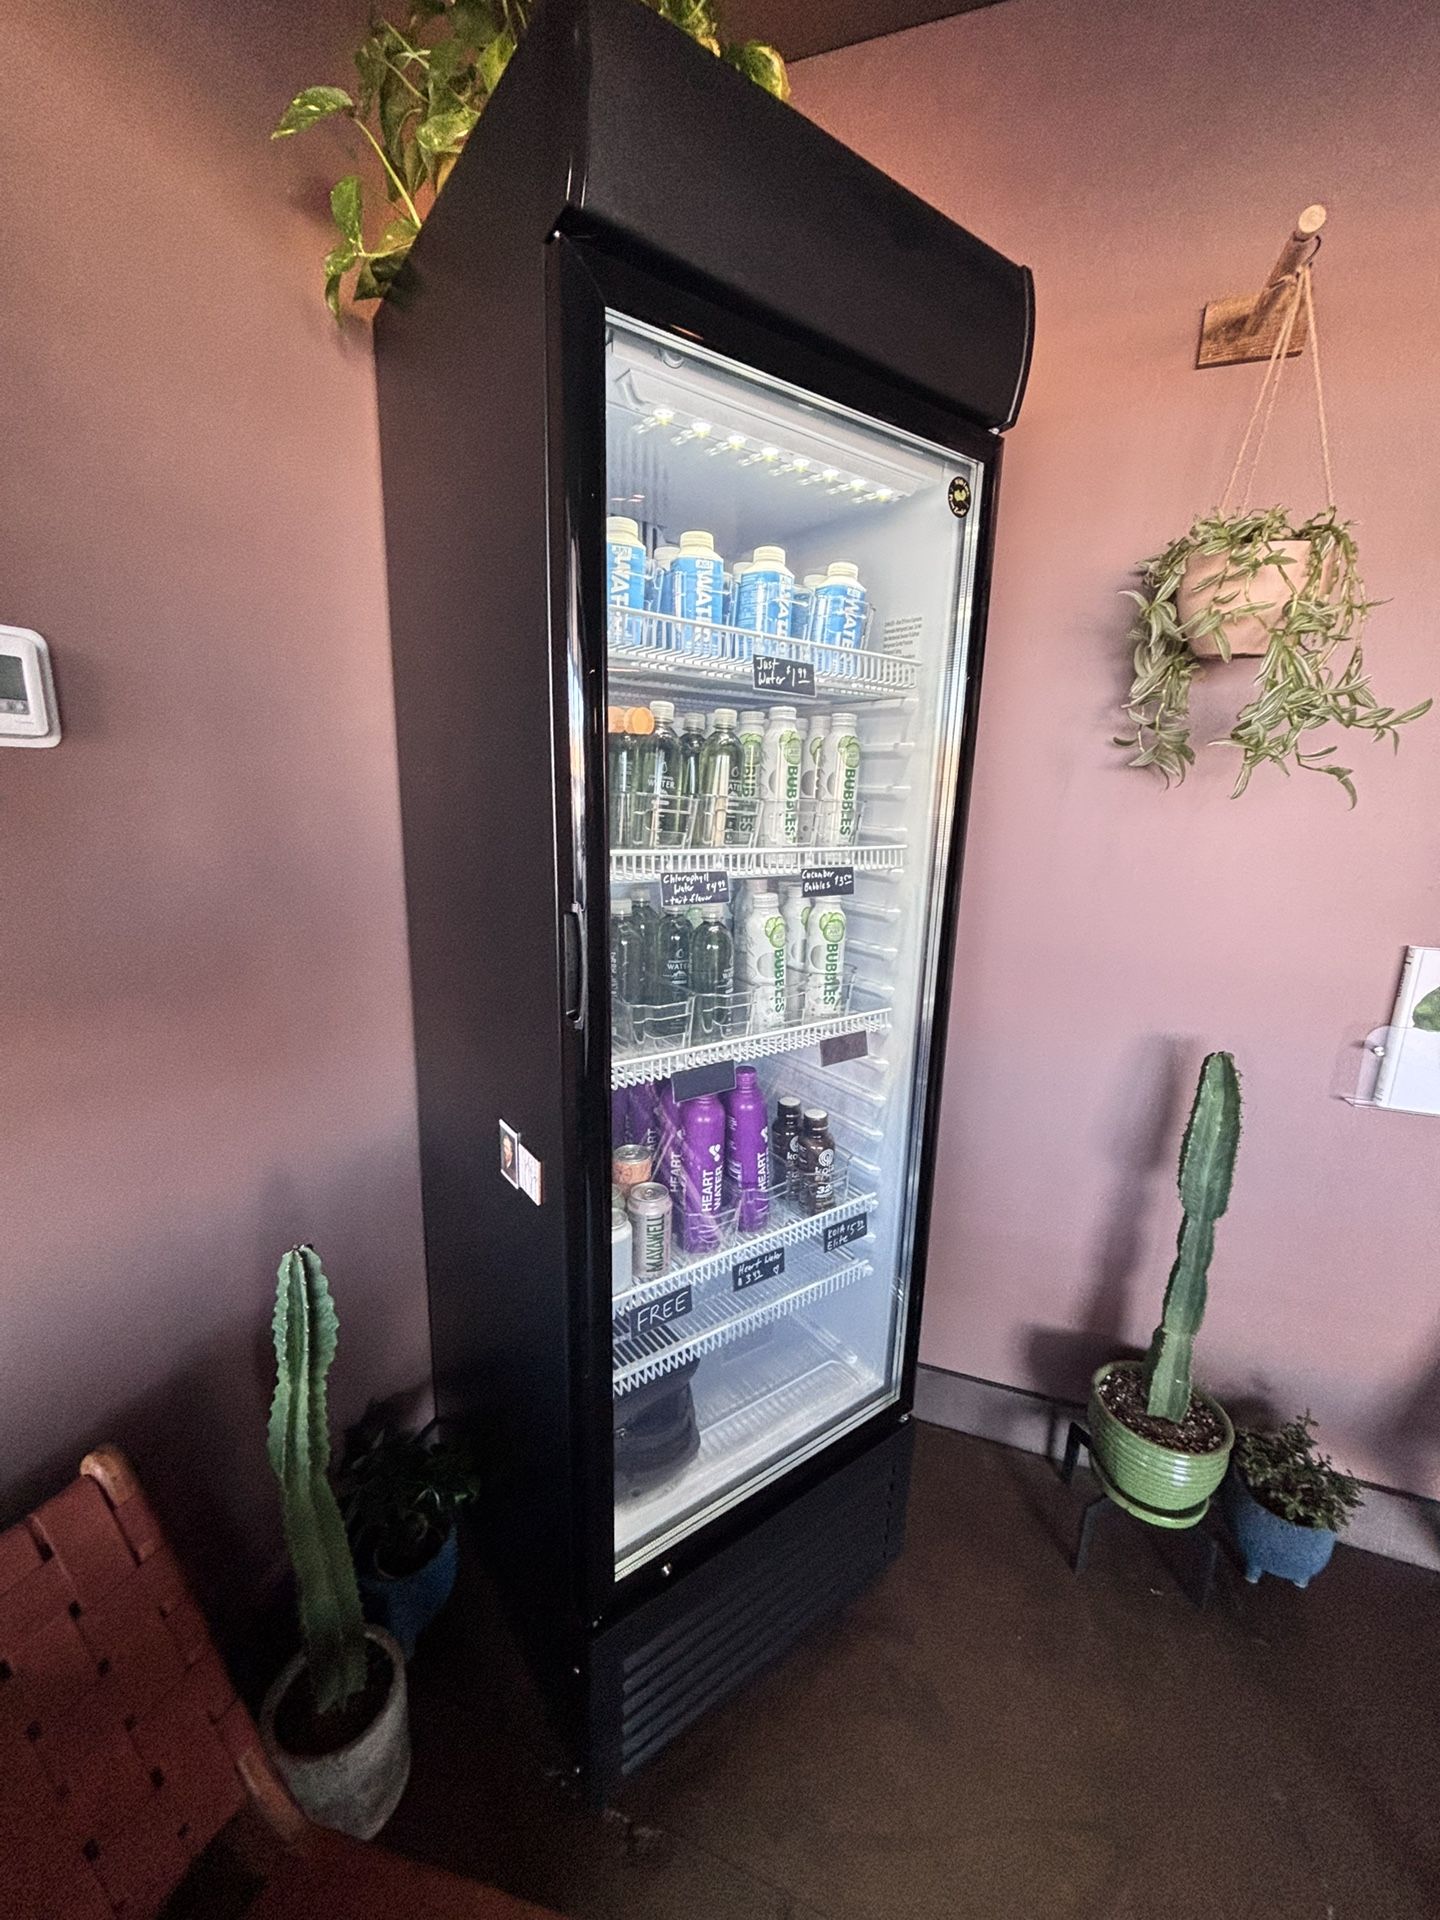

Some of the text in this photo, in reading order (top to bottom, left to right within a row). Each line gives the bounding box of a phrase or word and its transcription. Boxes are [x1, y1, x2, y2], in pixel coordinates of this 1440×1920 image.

[756, 657, 780, 670] Just
[758, 671, 786, 685] Water
[784, 766, 798, 836] BUBBLES
[840, 769, 856, 835] BUBBLES
[663, 872, 709, 885] Chlorophyll
[823, 943, 839, 1005] BUBBLES
[670, 1151, 681, 1193] HEART
[702, 1170, 714, 1212] HEART
[713, 1164, 724, 1211] WATER
[756, 1152, 768, 1193] HEART
[646, 1213, 665, 1273] MAYAWELL
[826, 1234, 848, 1250] Elite
[738, 1259, 762, 1276] Heart
[637, 1291, 689, 1332] FREE
